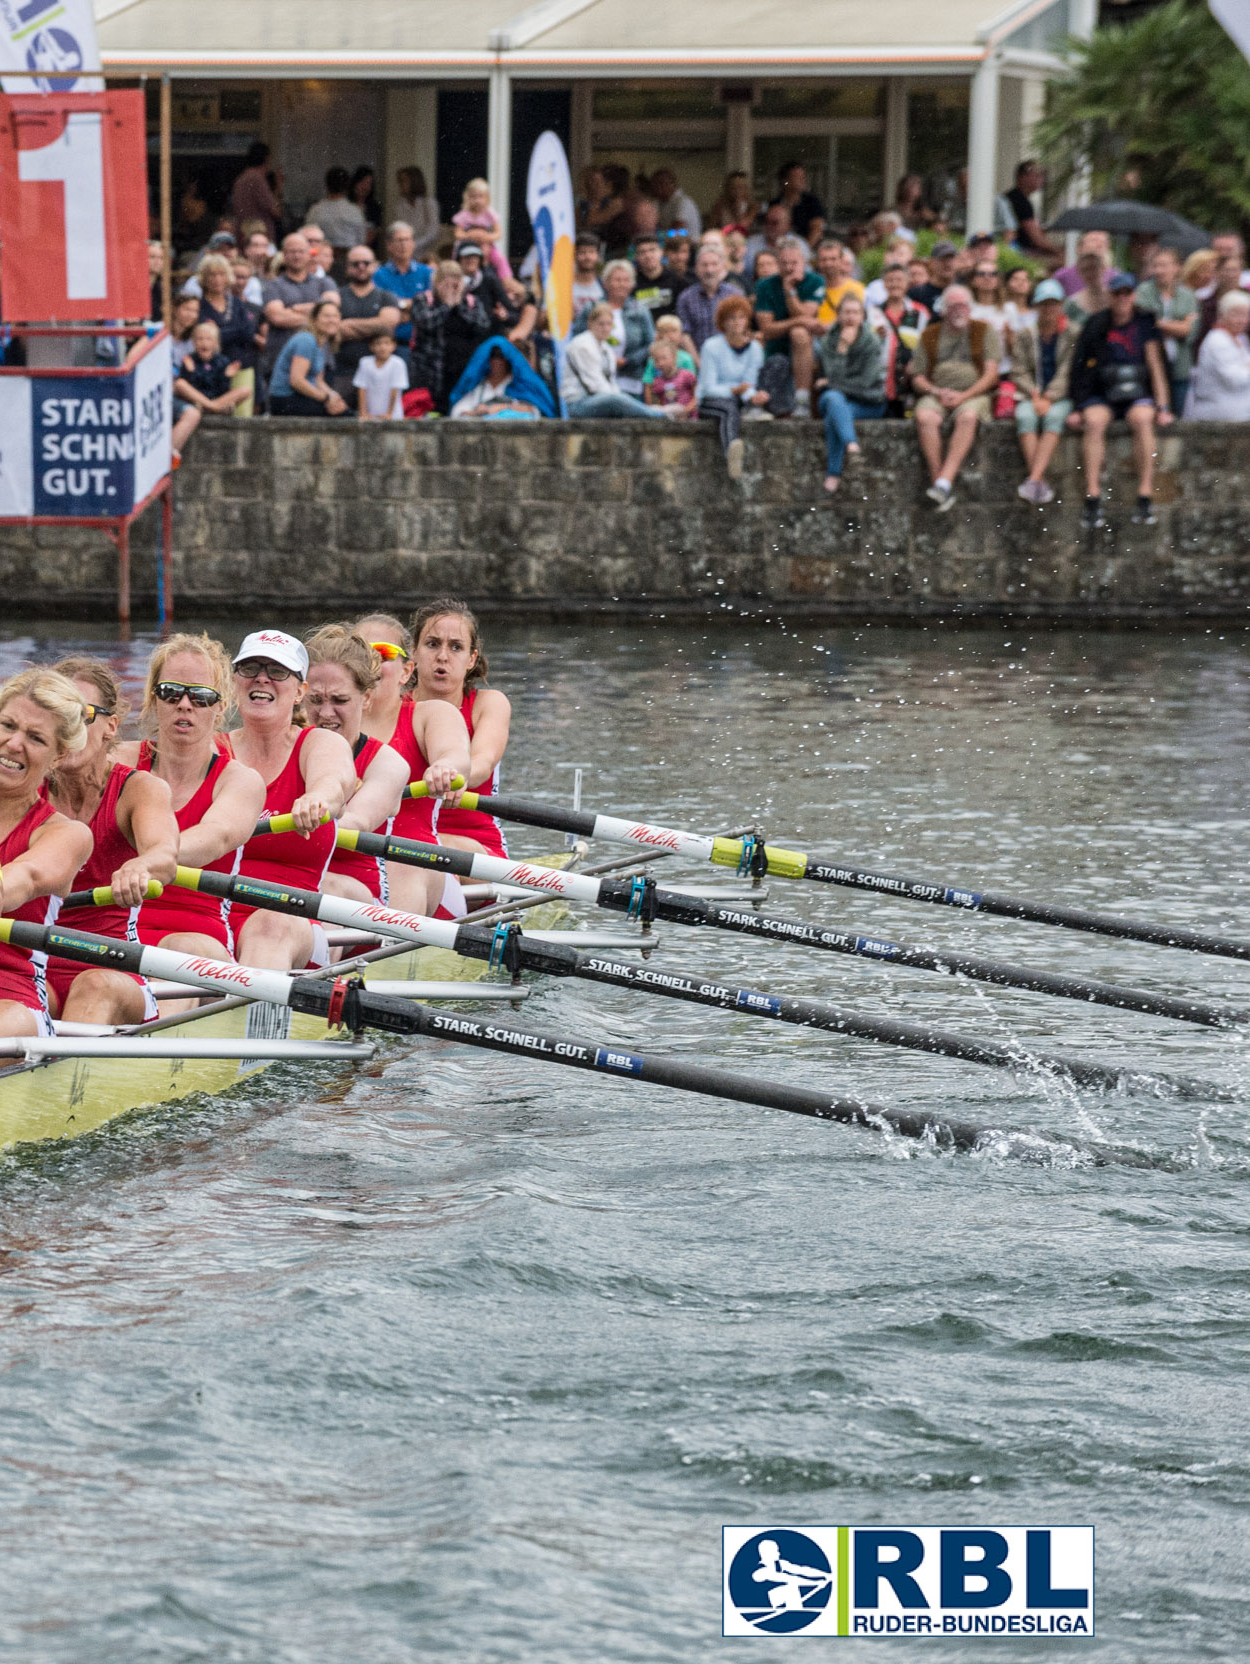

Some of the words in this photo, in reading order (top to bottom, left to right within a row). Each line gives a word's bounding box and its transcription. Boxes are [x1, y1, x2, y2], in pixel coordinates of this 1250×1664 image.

[17, 111, 107, 300] 1
[42, 467, 117, 497] GUT.
[622, 822, 683, 851] Melitta
[502, 863, 567, 894] Melitta
[816, 865, 855, 882] STARK.
[856, 874, 910, 893] SCHNELL.
[953, 891, 975, 905] RBL
[351, 904, 423, 932] Melitta
[718, 910, 761, 928] STARK.
[762, 919, 819, 941] SCHNELL.
[821, 931, 849, 947] GUT.
[865, 941, 888, 953] RBL
[176, 958, 253, 987] Melitta
[588, 959, 633, 979] STARK.
[635, 969, 697, 993] SCHNELL.
[747, 994, 772, 1008] RBL
[433, 1016, 482, 1037] STARK.
[484, 1026, 552, 1052] SCHNELL.
[554, 1042, 588, 1060] GUT.
[606, 1053, 634, 1067] RBL
